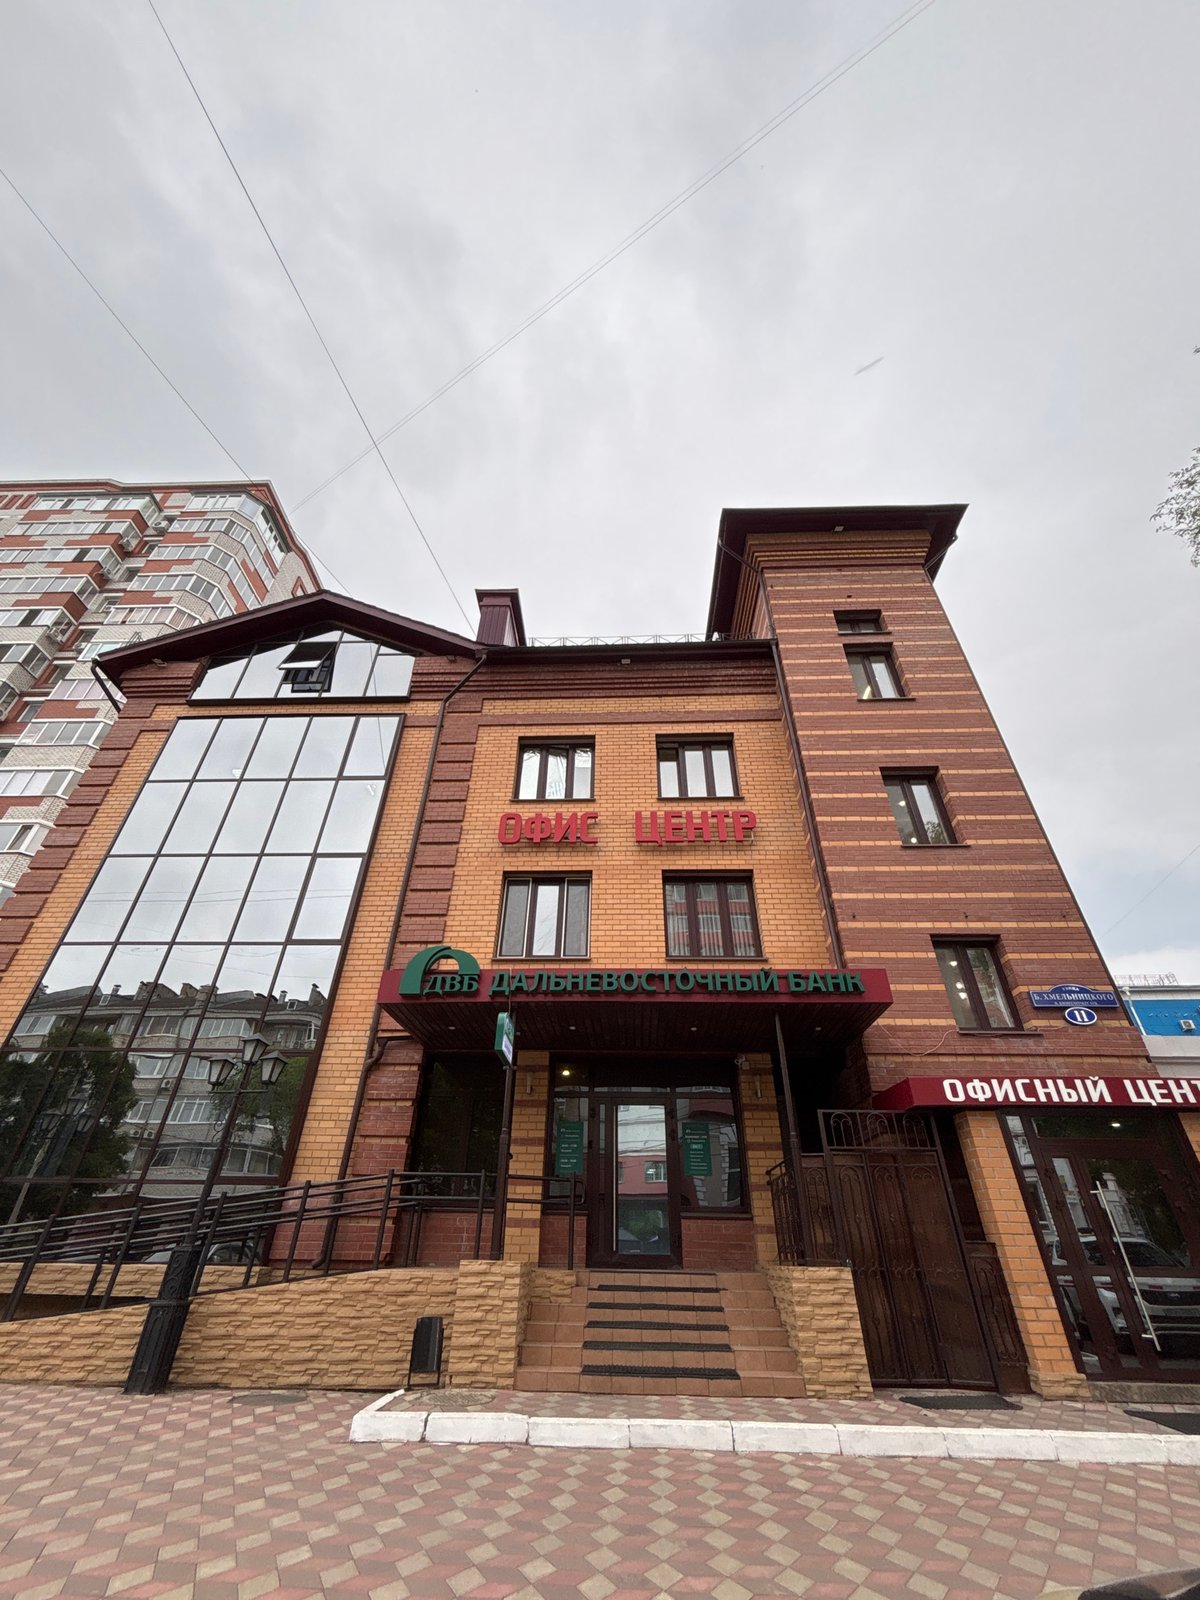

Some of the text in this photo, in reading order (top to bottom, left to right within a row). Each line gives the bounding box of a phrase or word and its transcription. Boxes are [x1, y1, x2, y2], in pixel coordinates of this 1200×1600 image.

[498, 810, 757, 847] ОФИС ЦЕНТР
[423, 974, 480, 996] ДВБ
[489, 968, 866, 998] ДАЛЬНЕВОСТОЧНЫЙ БАНК
[1043, 993, 1114, 1001] ХМЕЛЬНИЦКОГО
[1073, 1010, 1089, 1022] 11
[942, 1076, 1113, 1103] ОФИСНЫЙ
